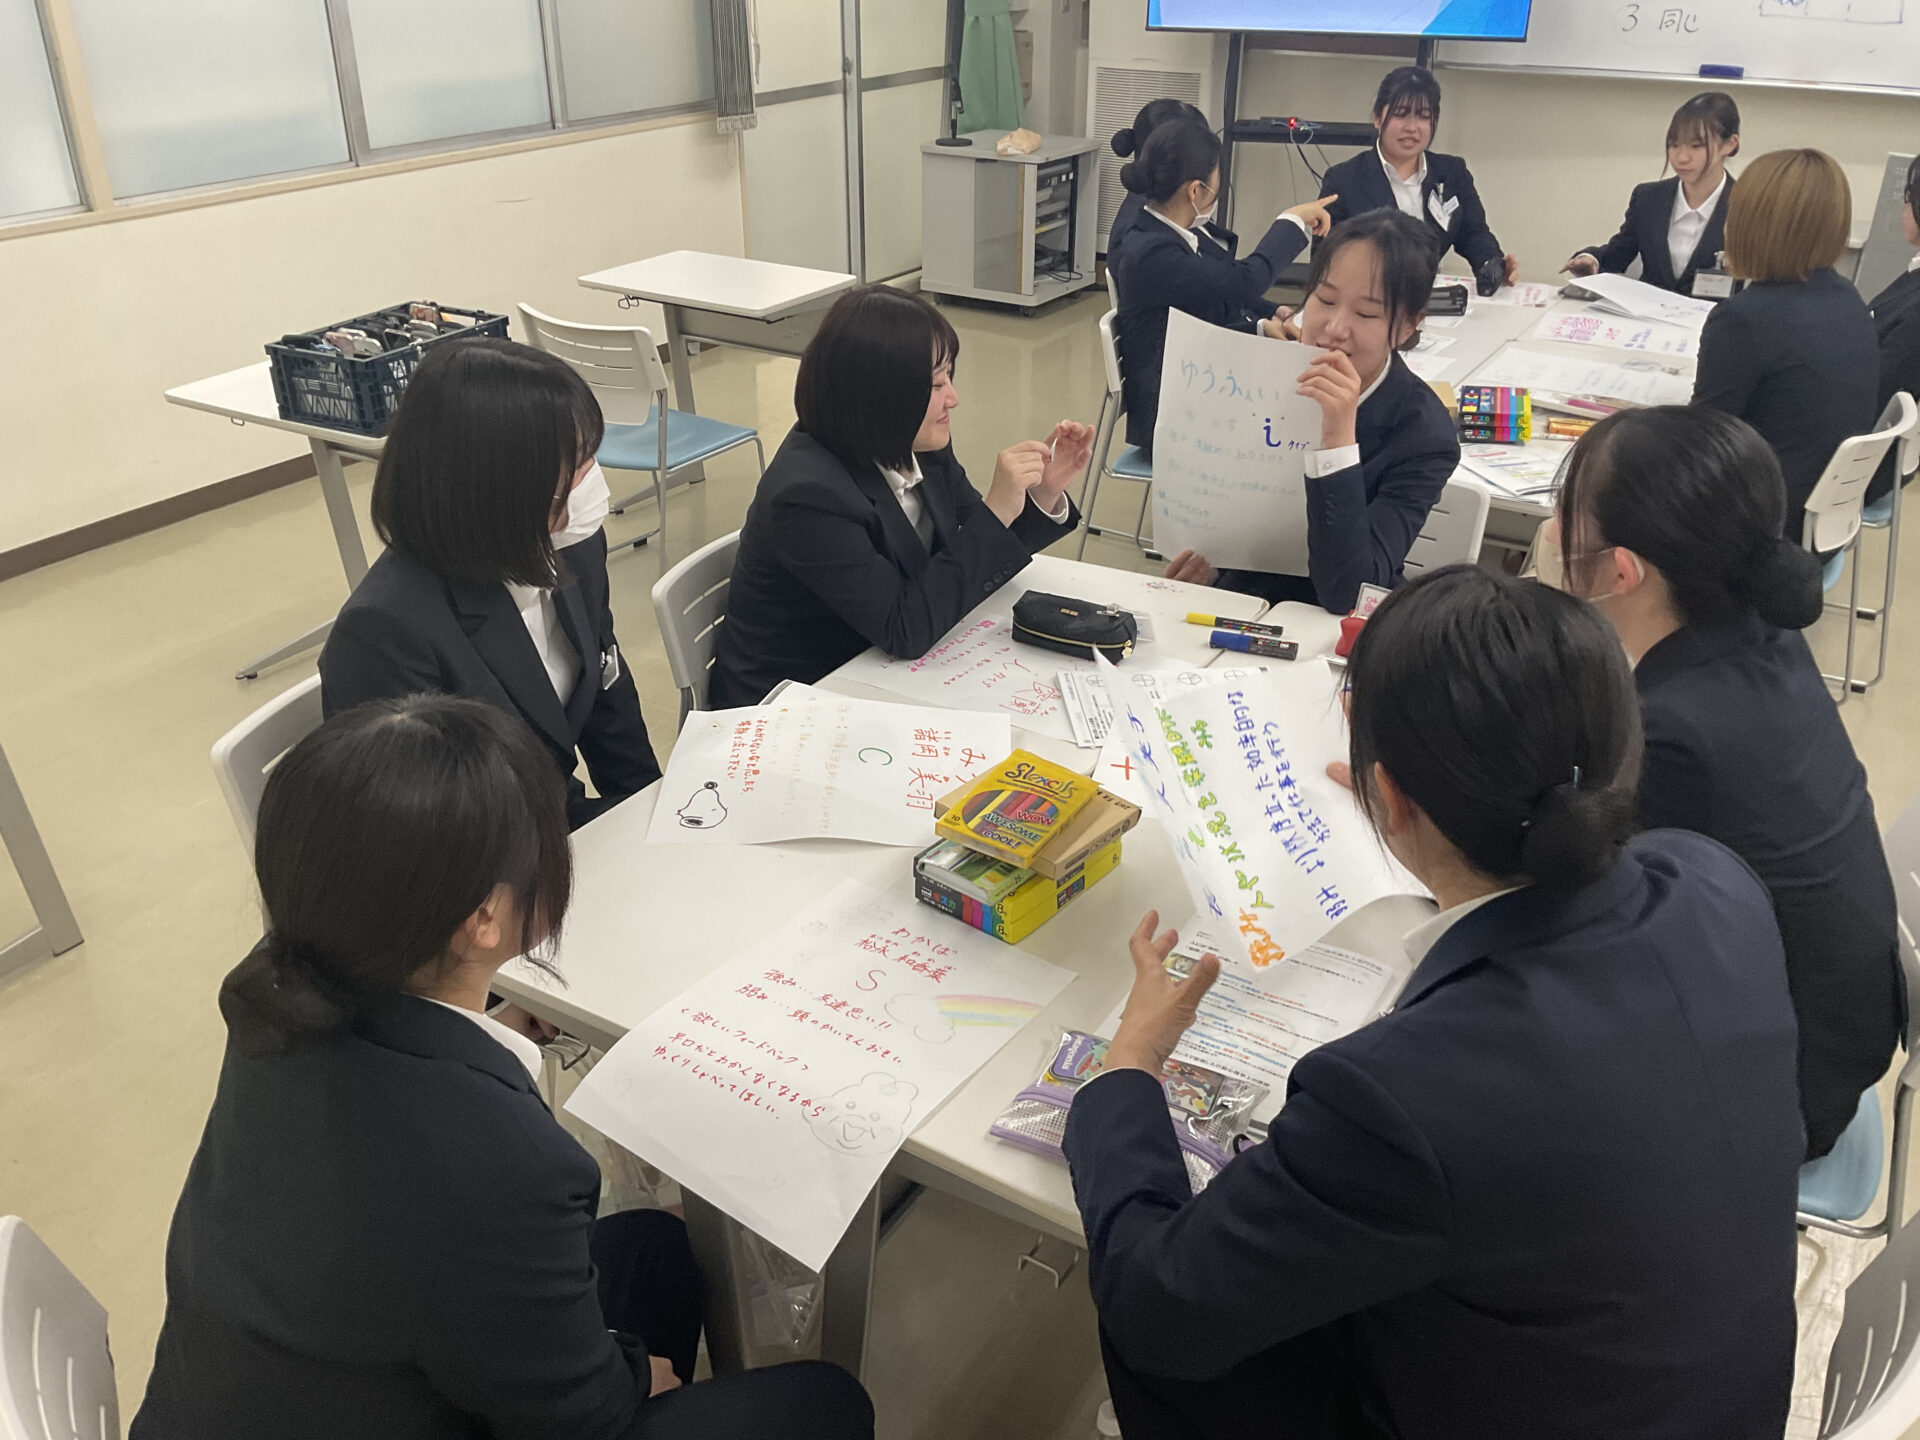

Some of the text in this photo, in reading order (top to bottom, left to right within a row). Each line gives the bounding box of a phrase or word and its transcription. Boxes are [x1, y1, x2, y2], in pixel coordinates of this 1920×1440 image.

[1621, 3, 1700, 34] 3 同じ
[857, 746, 893, 767] C
[1262, 721, 1332, 844] 方法で仕事を行う
[981, 812, 1042, 841] AWESOME
[1016, 809, 1056, 826] WOW
[982, 829, 1023, 849] COOL!
[1315, 884, 1349, 920] 弱み
[891, 926, 959, 956] わかば
[1239, 907, 1286, 968] 強み
[854, 937, 950, 984] 松永 和香葉
[855, 969, 888, 991] S
[1061, 1034, 1085, 1071] patagonia
